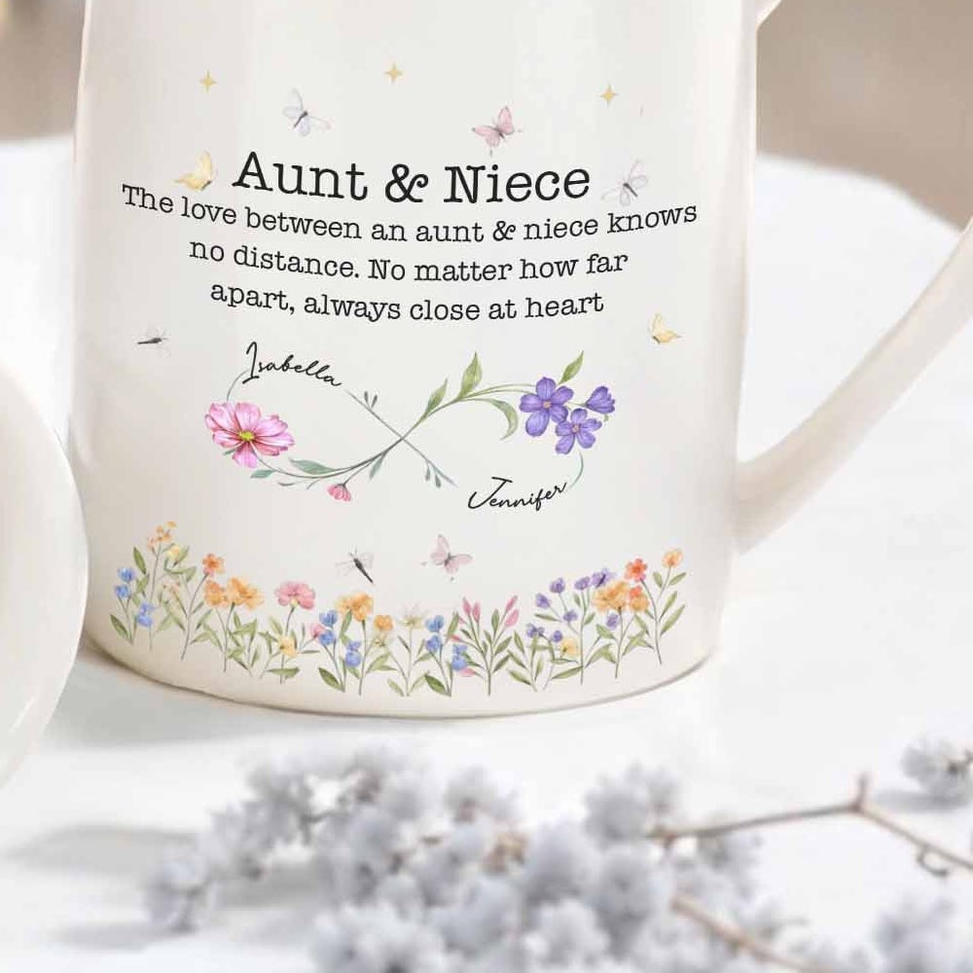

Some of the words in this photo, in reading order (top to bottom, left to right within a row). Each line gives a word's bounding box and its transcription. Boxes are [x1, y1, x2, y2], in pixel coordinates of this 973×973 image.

[230, 150, 369, 202] Aunt
[384, 163, 430, 204] &
[443, 163, 591, 205] Niece
[121, 183, 174, 214] The
[180, 195, 237, 225] love
[244, 205, 363, 240] between
[370, 223, 408, 243] an
[415, 221, 485, 243] aunt
[492, 220, 517, 242] &
[522, 217, 599, 241] niece
[606, 204, 698, 235] knows
[188, 241, 225, 263] no
[233, 244, 360, 279] distance.
[367, 258, 406, 281] No
[413, 260, 514, 282] matter
[518, 258, 580, 280] how
[585, 252, 629, 275] far
[210, 283, 295, 316] apart,
[303, 293, 402, 323] always
[409, 298, 481, 322] close
[487, 298, 518, 320] at
[524, 291, 605, 319] heart
[242, 340, 343, 389] Isabella
[467, 476, 568, 512] Jennifer
